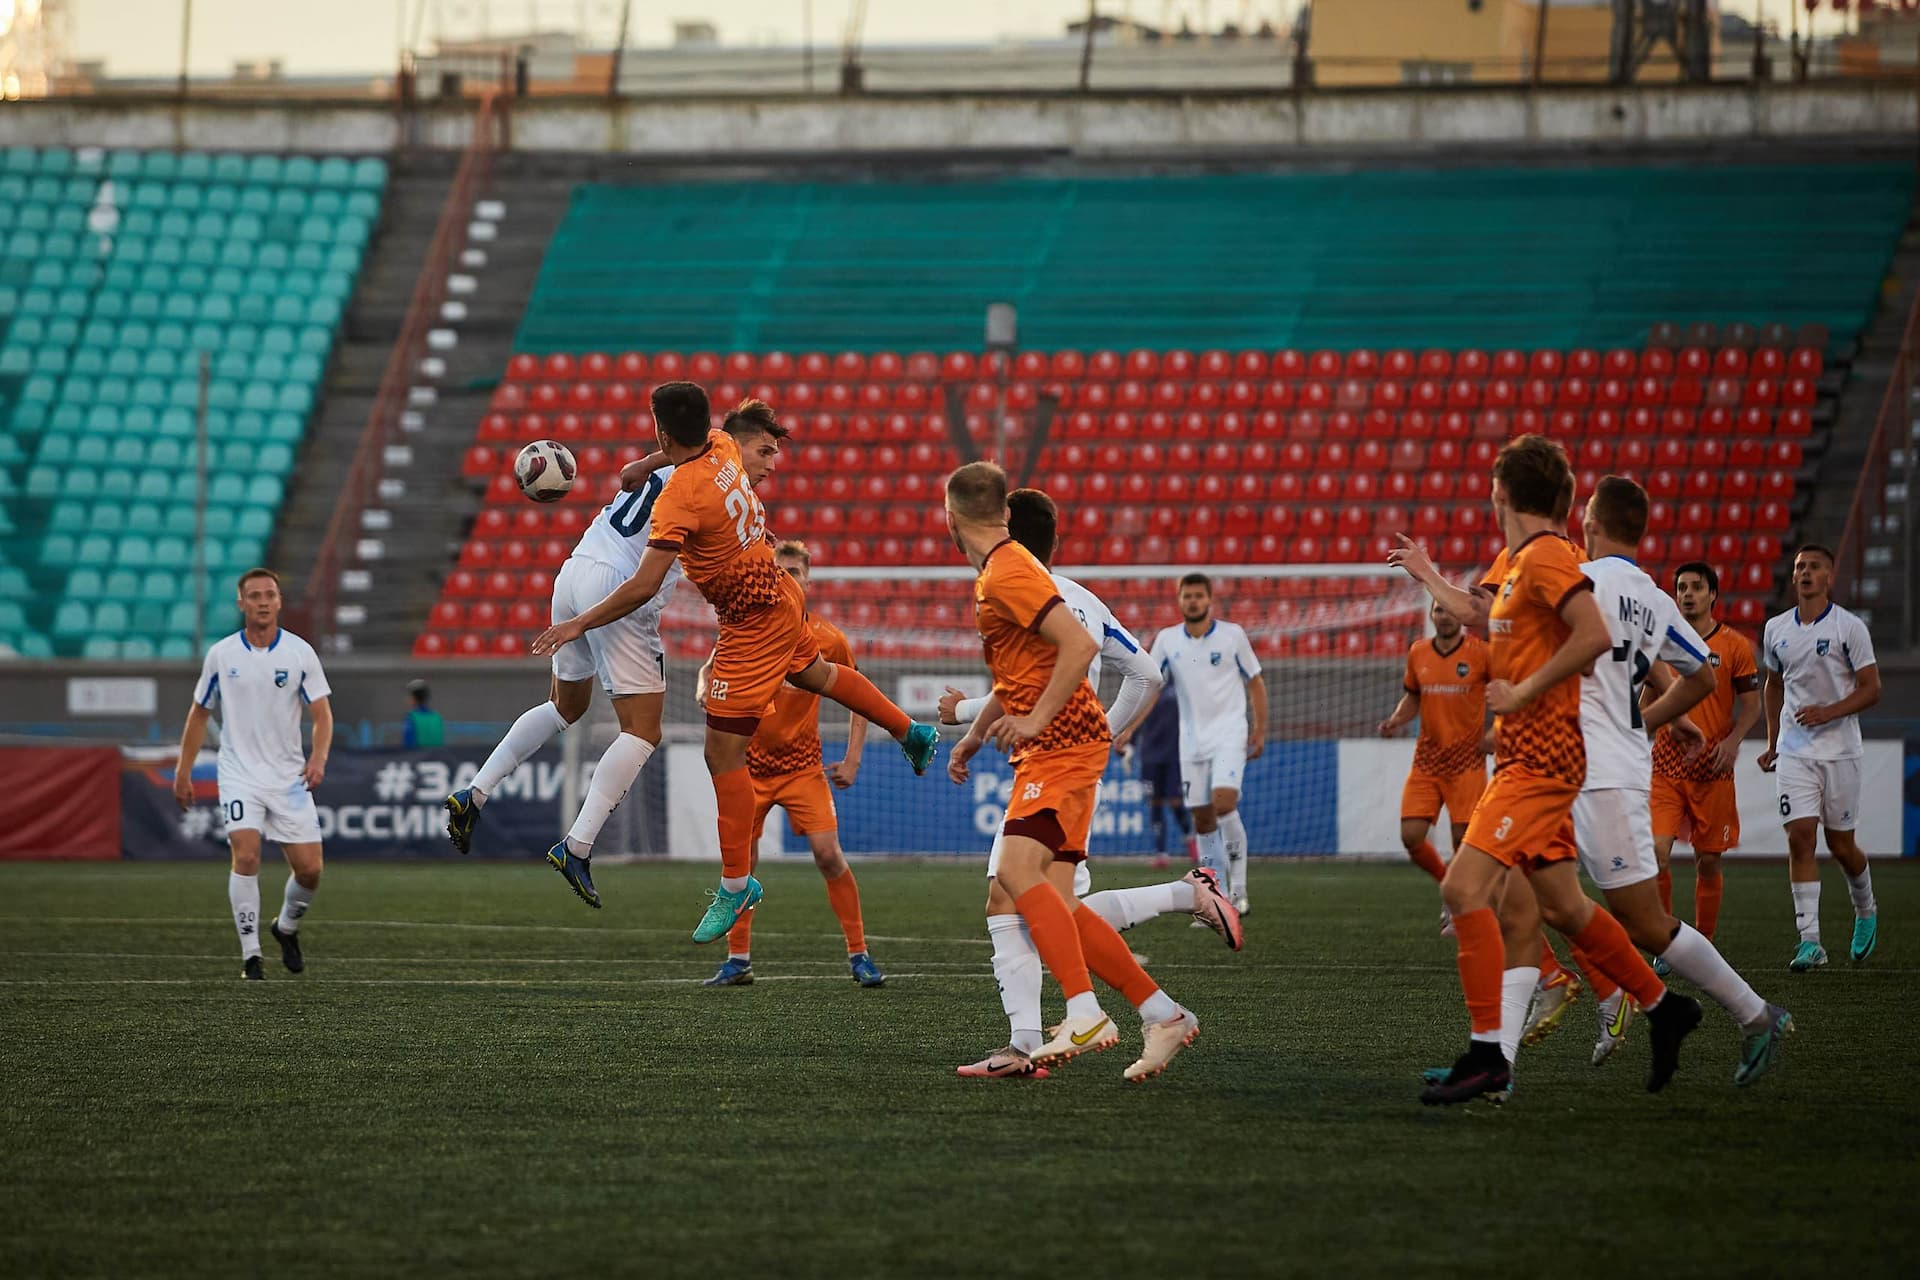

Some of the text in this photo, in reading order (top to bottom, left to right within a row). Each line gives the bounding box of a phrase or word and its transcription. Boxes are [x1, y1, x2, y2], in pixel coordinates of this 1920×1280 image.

[711, 679, 729, 700] 22
[1779, 794, 1791, 816] 6
[1494, 816, 1513, 841] 3
[239, 912, 255, 923] 20
